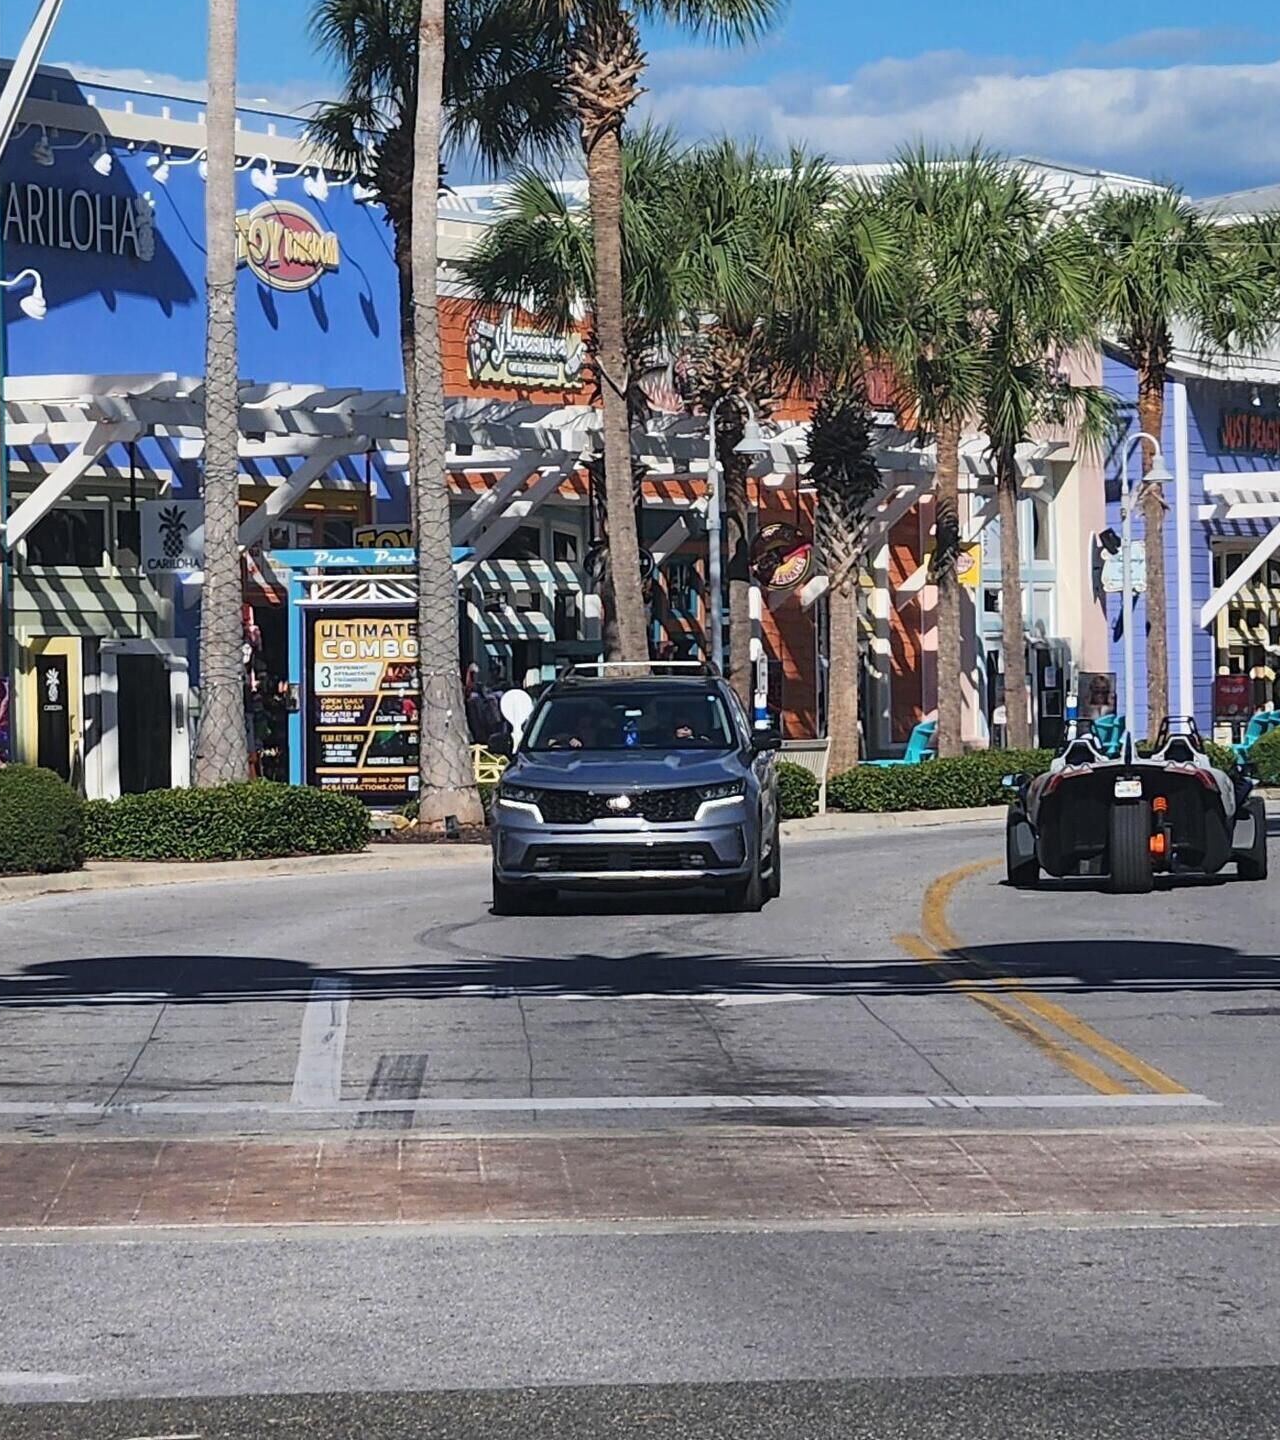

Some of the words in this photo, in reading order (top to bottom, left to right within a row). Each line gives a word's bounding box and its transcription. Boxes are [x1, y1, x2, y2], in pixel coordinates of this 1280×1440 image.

[3, 181, 141, 258] ARILOHA
[148, 557, 200, 570] CARILOHA
[313, 551, 359, 564] Pier
[321, 623, 418, 638] ULTIMATE
[321, 639, 419, 659] COMBO
[320, 665, 331, 688] 3
